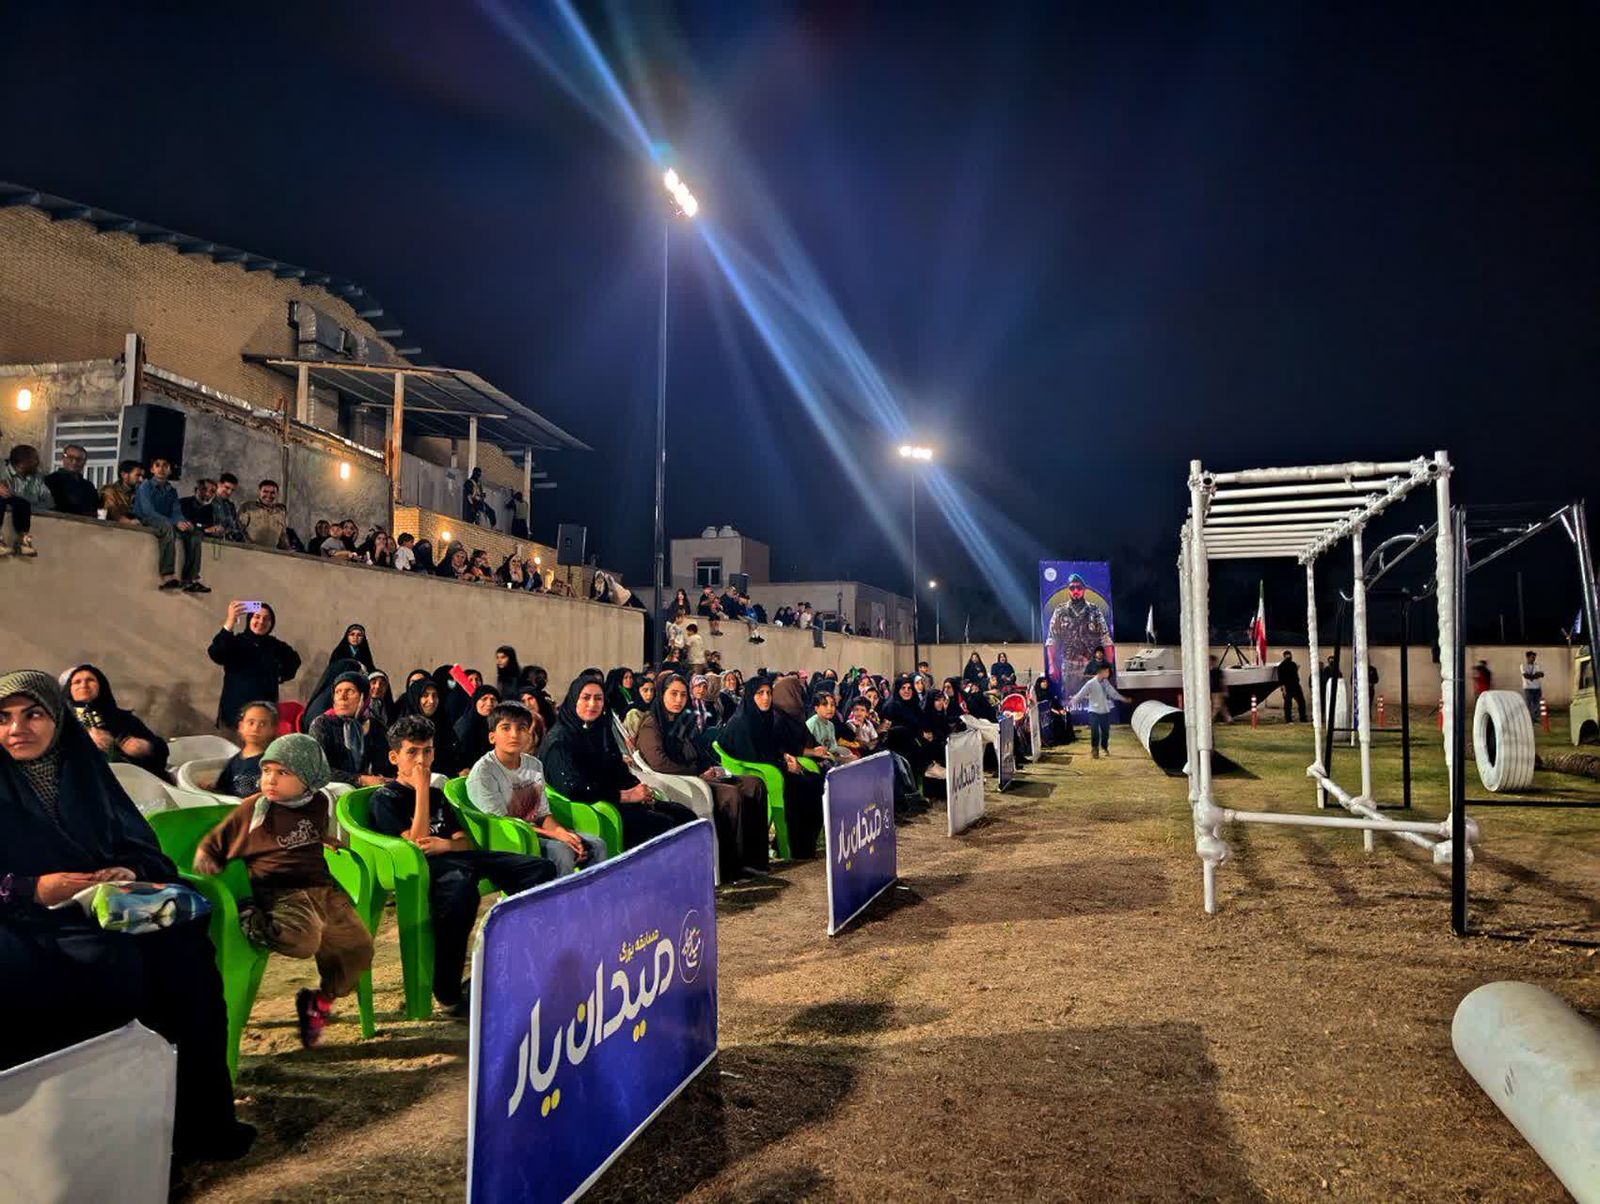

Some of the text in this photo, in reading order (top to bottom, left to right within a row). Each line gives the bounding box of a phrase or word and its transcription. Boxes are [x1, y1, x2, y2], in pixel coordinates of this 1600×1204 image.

[837, 817, 851, 871] یار
[850, 808, 881, 855] میدان
[619, 940, 635, 964] بزرگ
[634, 928, 660, 952] مسابقه
[508, 938, 675, 1118] میدان یار
